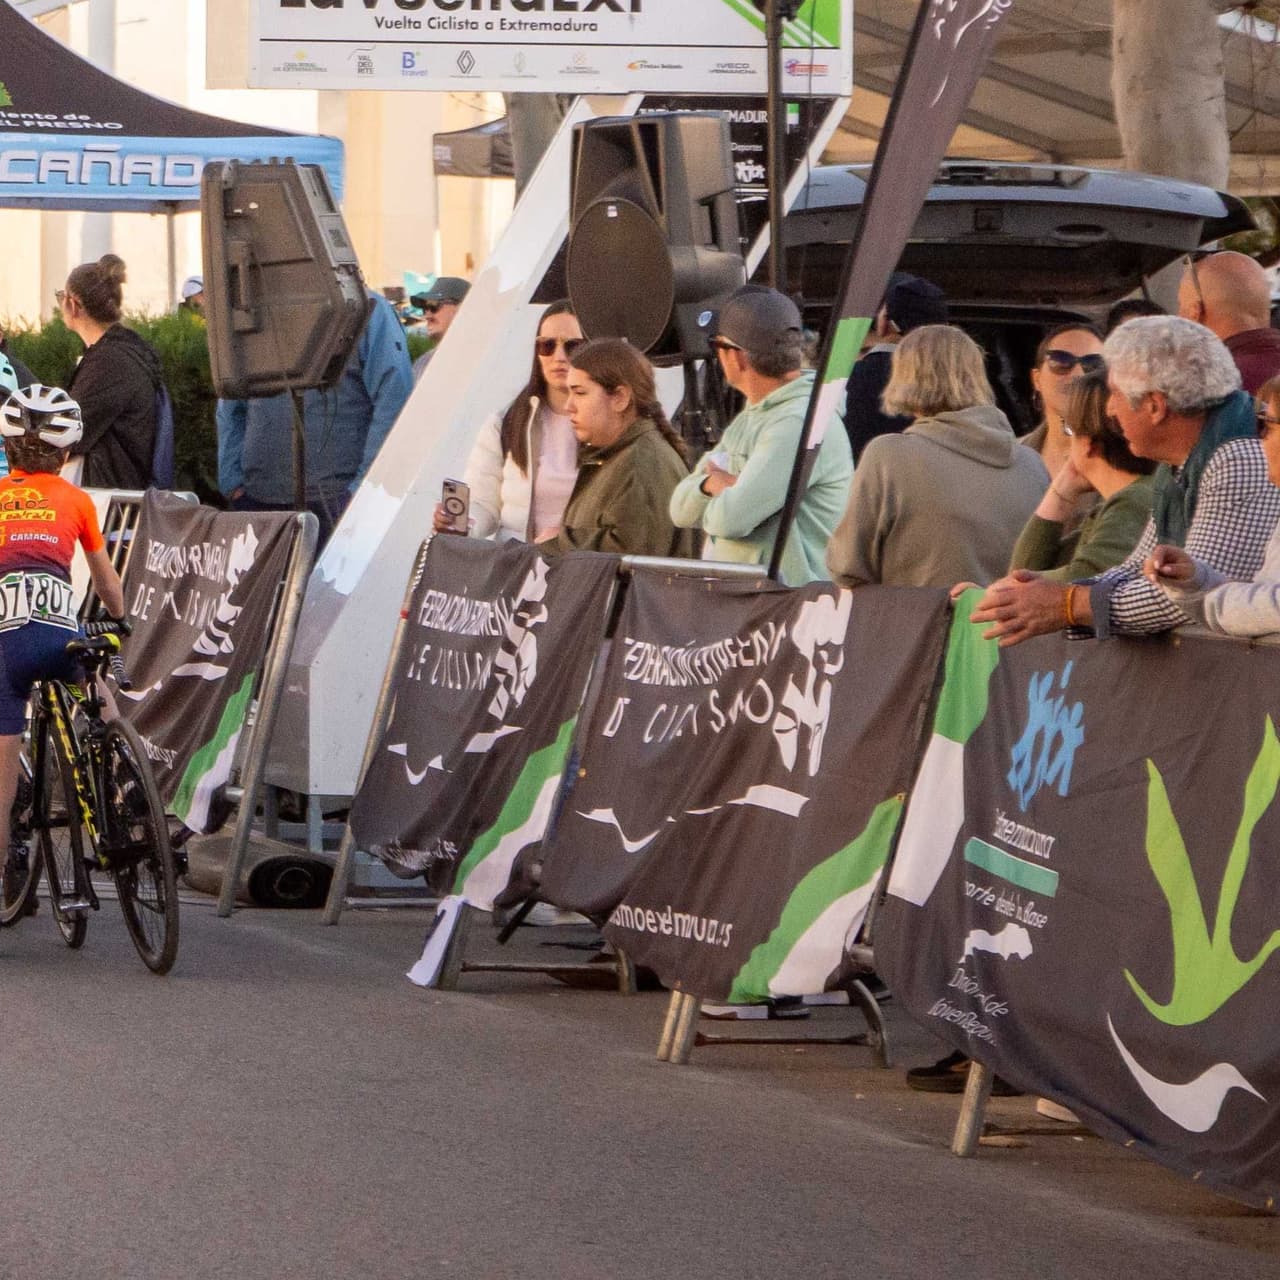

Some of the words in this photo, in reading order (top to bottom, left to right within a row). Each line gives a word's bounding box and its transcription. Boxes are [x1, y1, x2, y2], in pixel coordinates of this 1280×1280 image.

[374, 16, 422, 30] Vuelta
[427, 16, 480, 30] Ciclista
[484, 21, 494, 30] a
[499, 19, 599, 32] Extremadura
[62, 111, 91, 121] de
[22, 119, 124, 130] FRESNO
[9, 532, 60, 545] CAMACHO
[34, 576, 72, 614] 807
